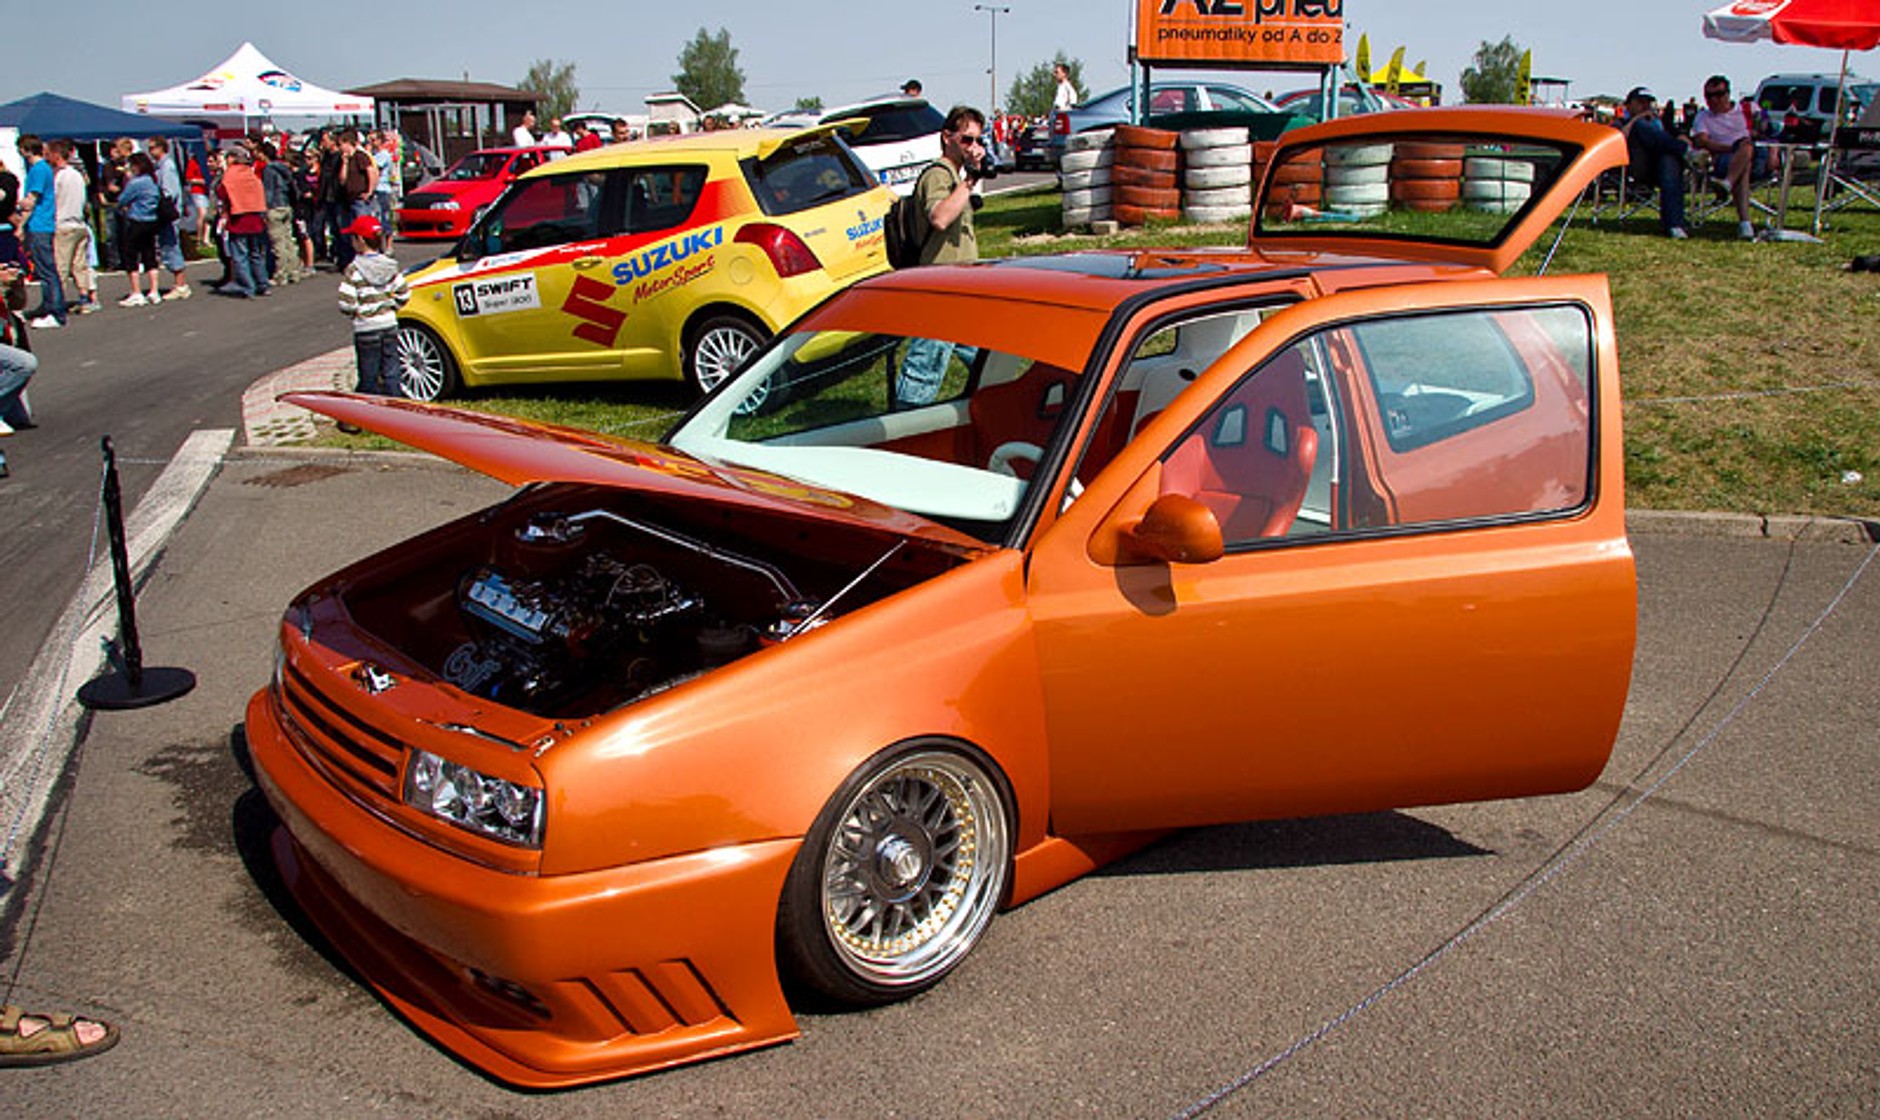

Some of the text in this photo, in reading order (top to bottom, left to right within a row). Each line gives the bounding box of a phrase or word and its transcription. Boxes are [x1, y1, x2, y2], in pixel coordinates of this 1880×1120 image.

[1158, 27, 1343, 45] pneumatiky od A do Z
[612, 226, 723, 285] SUZUKI
[457, 277, 533, 312] 13 SWIFT
